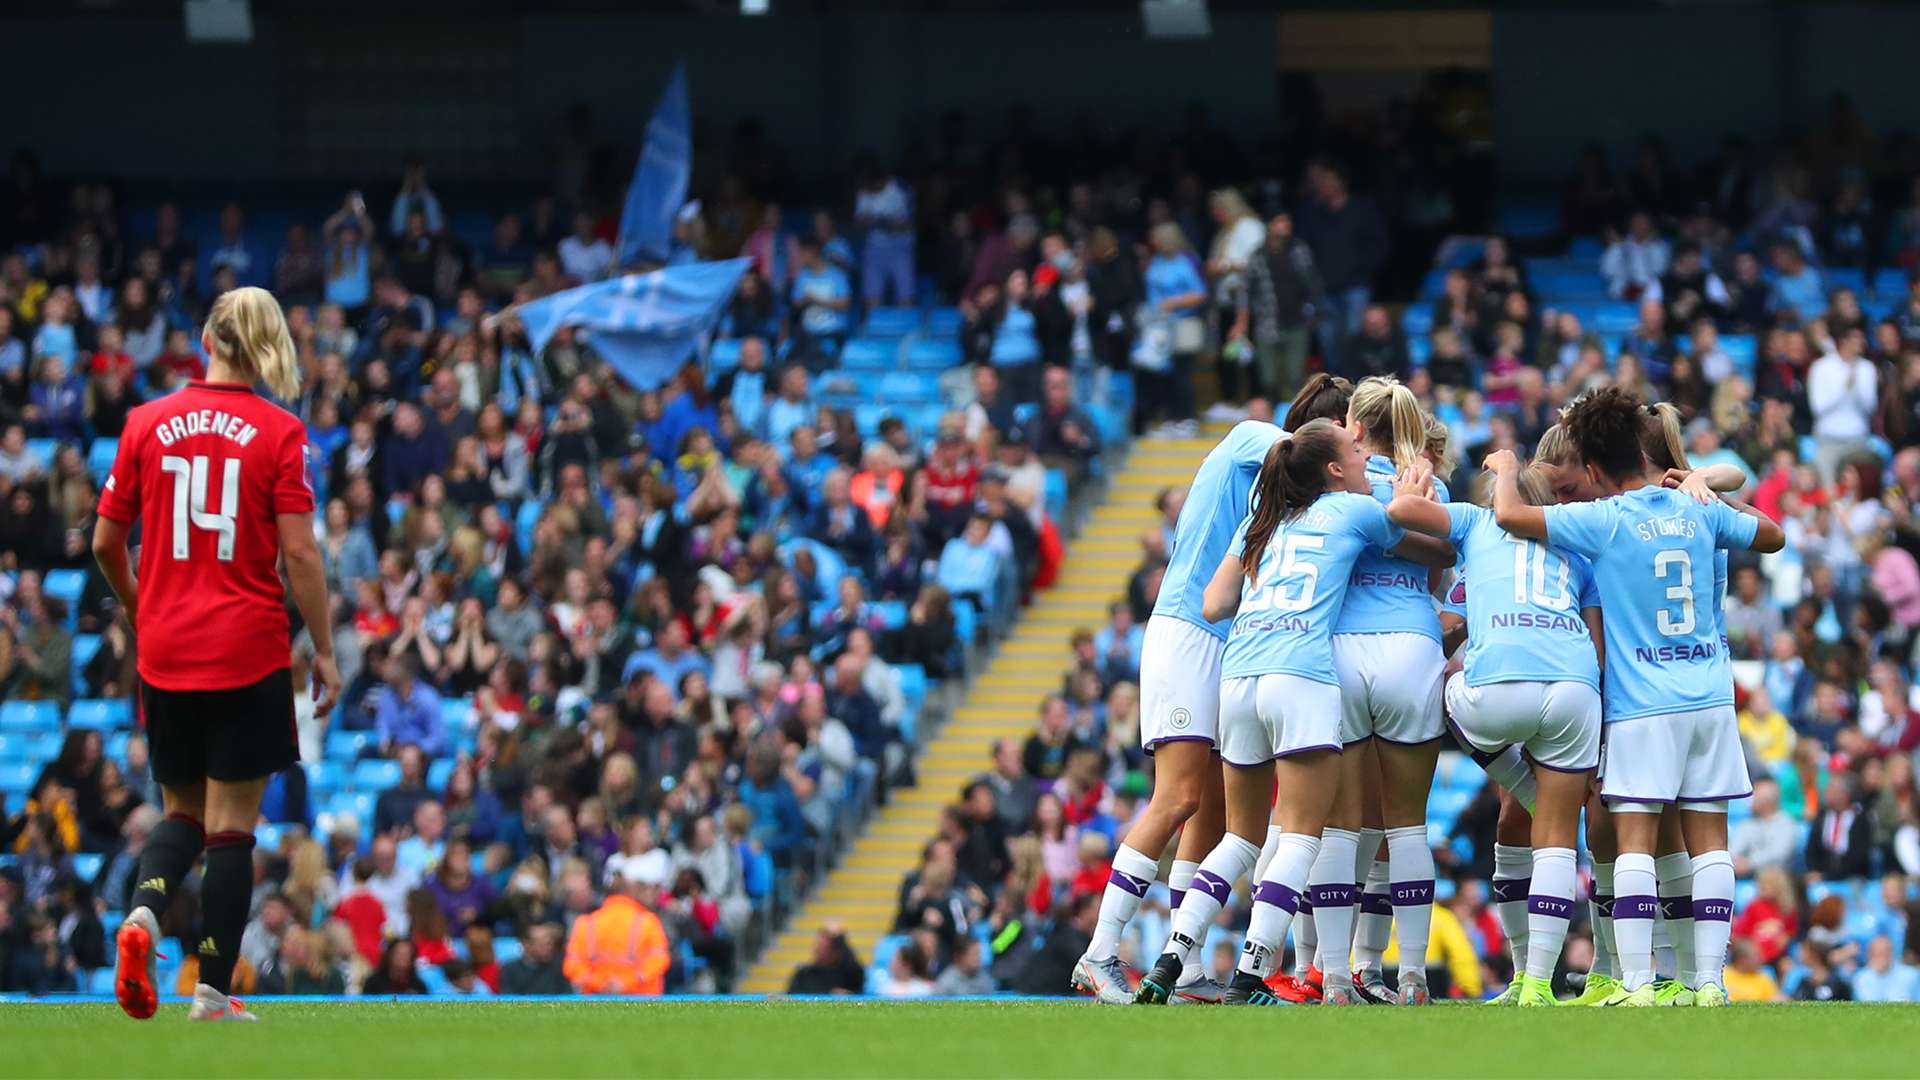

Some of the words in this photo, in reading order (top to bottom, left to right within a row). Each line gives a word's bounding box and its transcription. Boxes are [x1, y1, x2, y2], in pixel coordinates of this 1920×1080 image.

[155, 409, 257, 447] GROENEN
[161, 455, 241, 561] 14
[1636, 517, 1697, 542] STOKES
[1240, 534, 1325, 612] 25
[1505, 532, 1571, 612] 10
[1654, 549, 1697, 637] 3
[1491, 612, 1583, 634] NISSAN
[1635, 642, 1717, 663] NISSAN
[1319, 890, 1349, 900] CITY
[1397, 888, 1428, 899] CITY
[1537, 901, 1567, 912] CITY
[1705, 905, 1730, 915] CITY
